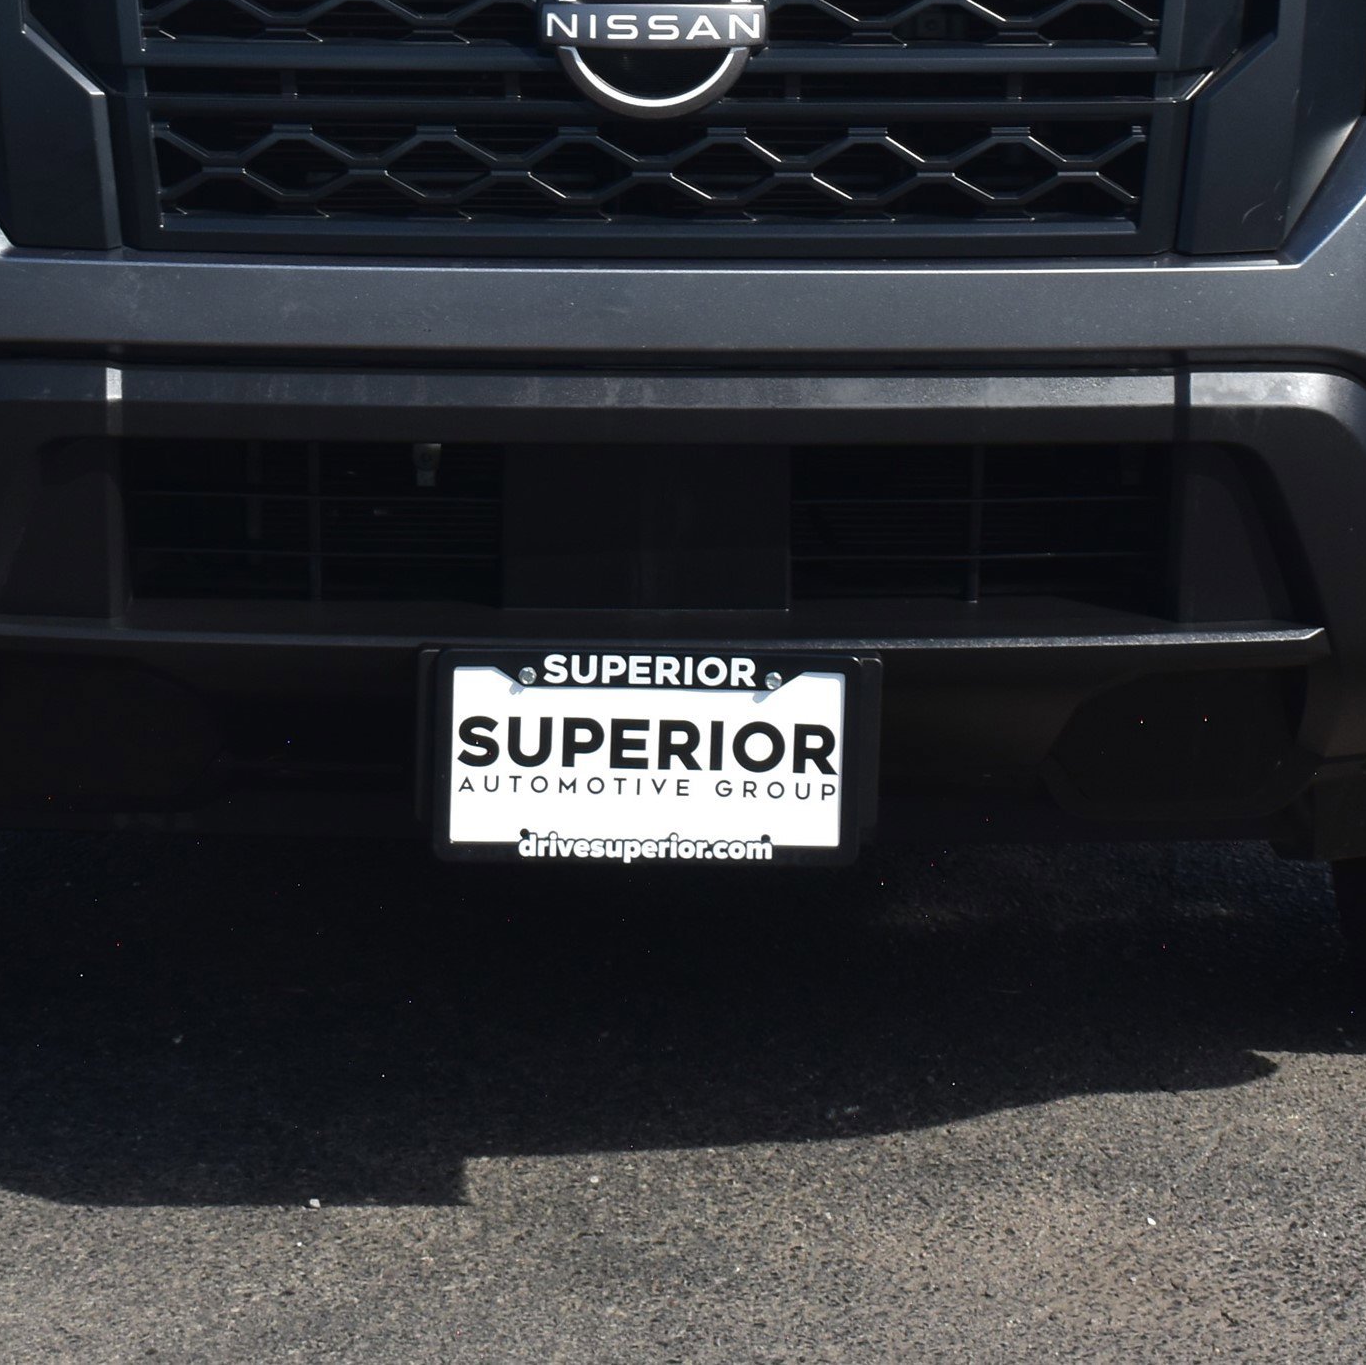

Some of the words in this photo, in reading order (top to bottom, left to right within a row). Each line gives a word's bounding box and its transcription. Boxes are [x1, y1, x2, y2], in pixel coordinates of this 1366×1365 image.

[546, 12, 761, 40] NISSAN
[543, 653, 757, 687] SUPERIOR
[457, 715, 839, 775] SUPERIOR
[458, 776, 691, 797] AUTOMOTIVE
[715, 780, 836, 801] GROUP
[518, 831, 773, 863] drivesuperior.com
